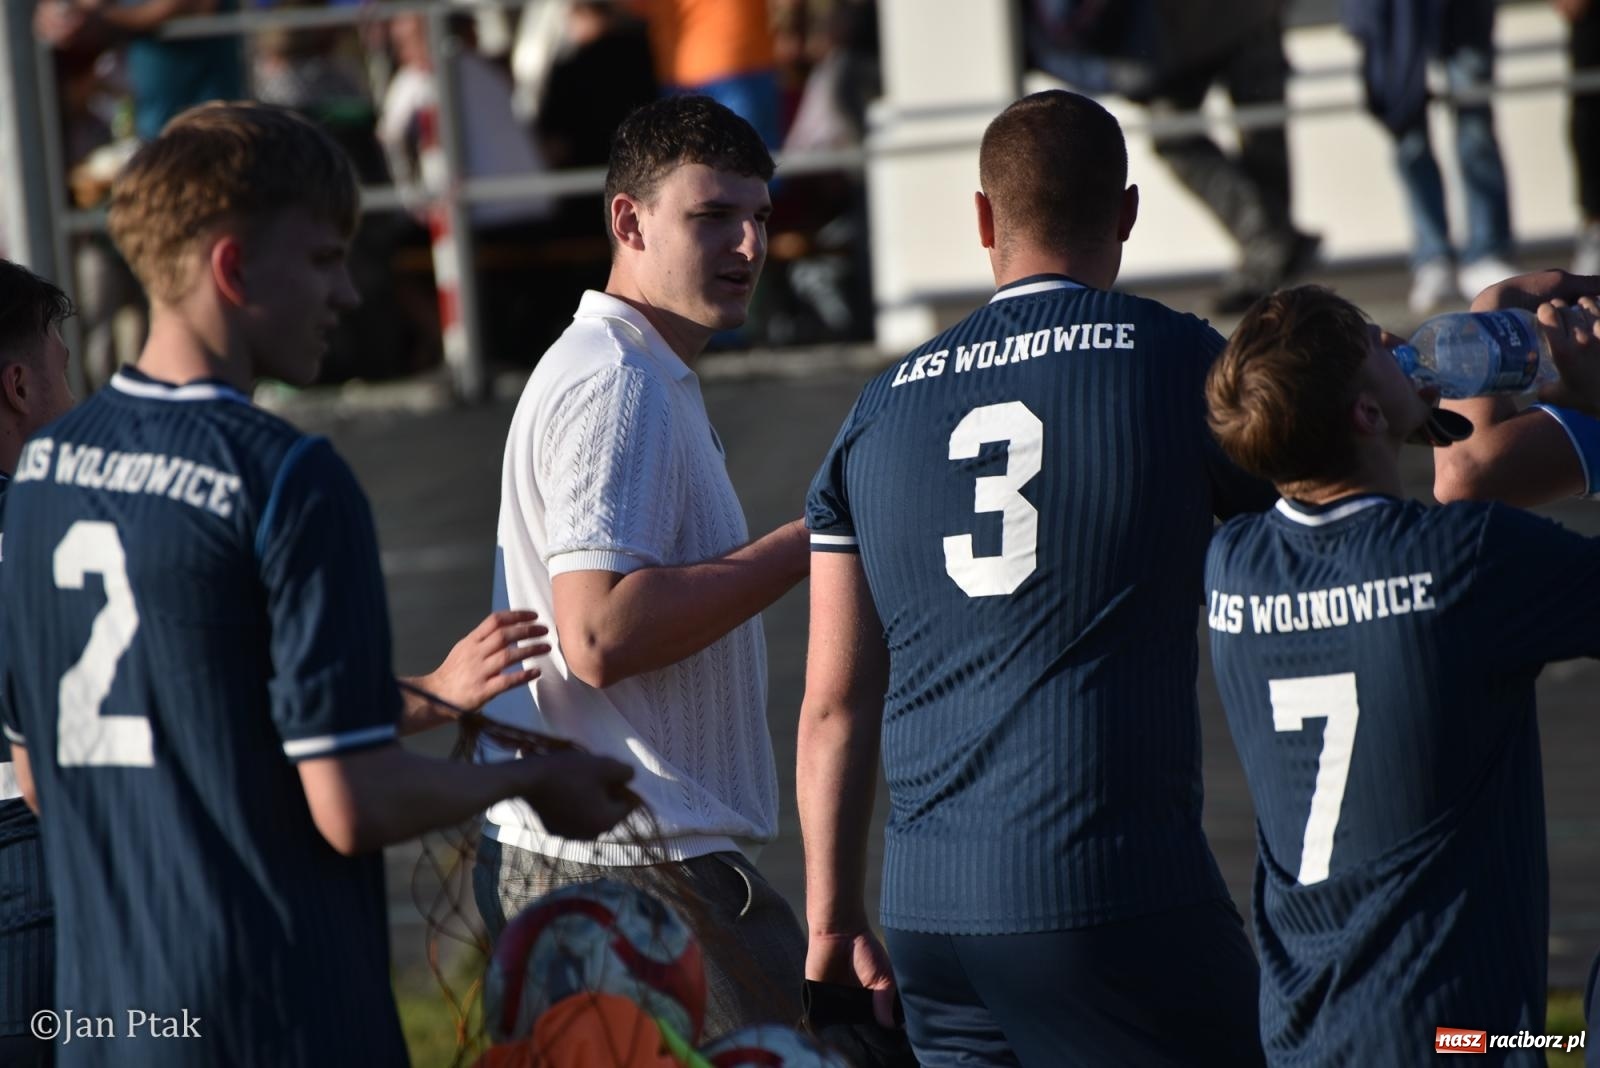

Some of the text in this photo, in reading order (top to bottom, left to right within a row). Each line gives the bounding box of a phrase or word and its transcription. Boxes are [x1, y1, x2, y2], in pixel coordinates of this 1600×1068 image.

[891, 323, 1136, 388] LKS WOJNOWICE
[55, 443, 242, 518] WOJNOWICE
[943, 400, 1044, 598] 3
[53, 520, 155, 768] 2
[1250, 572, 1436, 634] WOJNOWICE
[1268, 672, 1359, 886] 7
